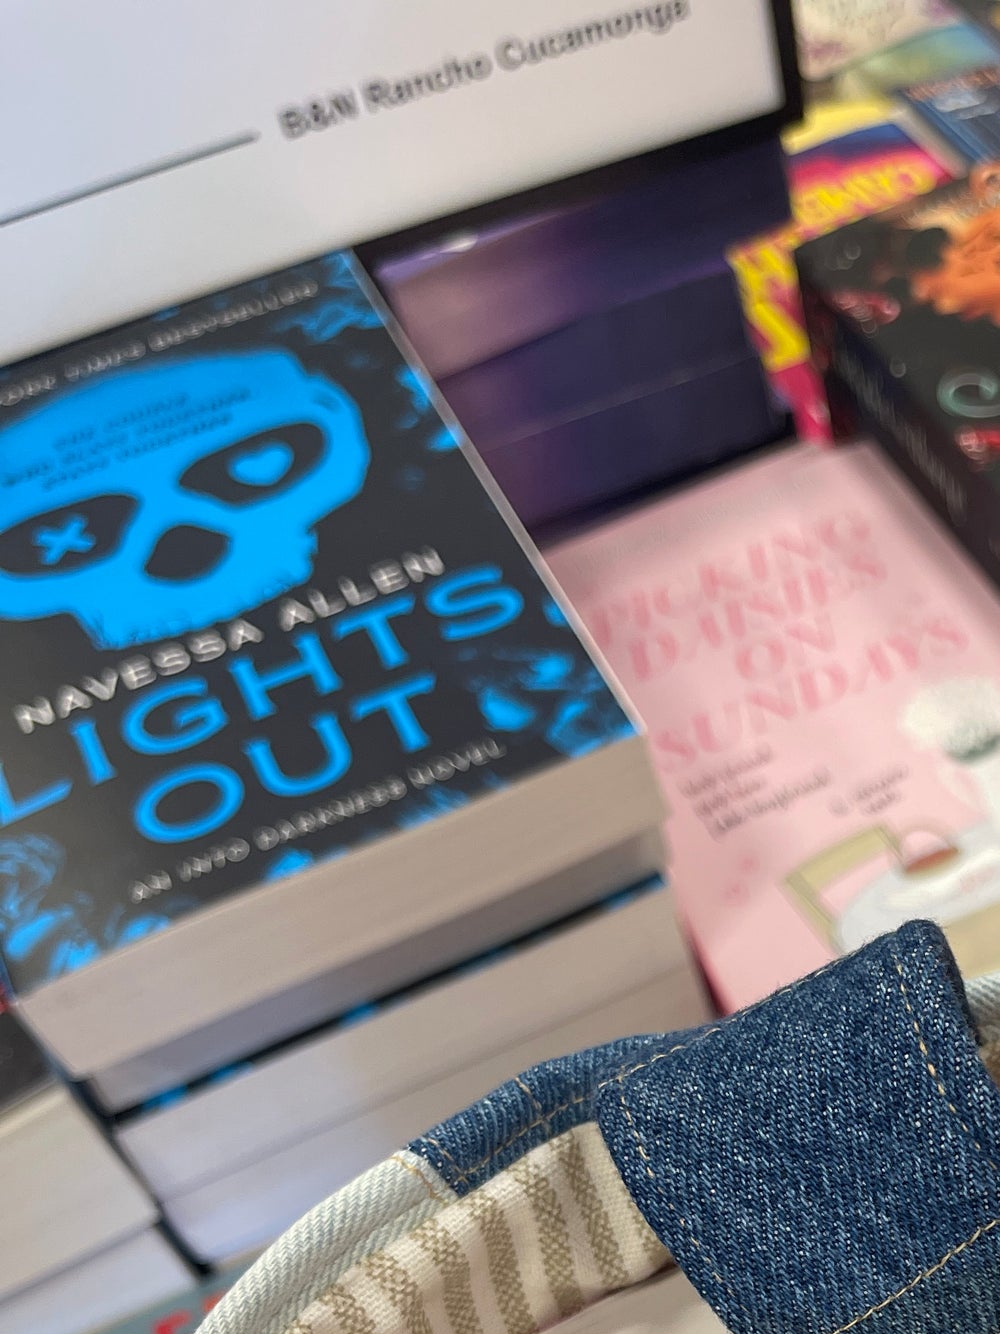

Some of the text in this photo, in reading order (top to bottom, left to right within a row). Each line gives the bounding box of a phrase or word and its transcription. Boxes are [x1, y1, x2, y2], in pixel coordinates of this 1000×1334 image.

[278, 0, 690, 140] B&N Rancho Cucamonga
[0, 566, 523, 827] LIGHTS
[15, 545, 445, 734] NAVESSA ALLEN
[133, 674, 436, 843] OUT
[252, 774, 408, 852] DARKNESS
[406, 736, 506, 790] NOVEL
